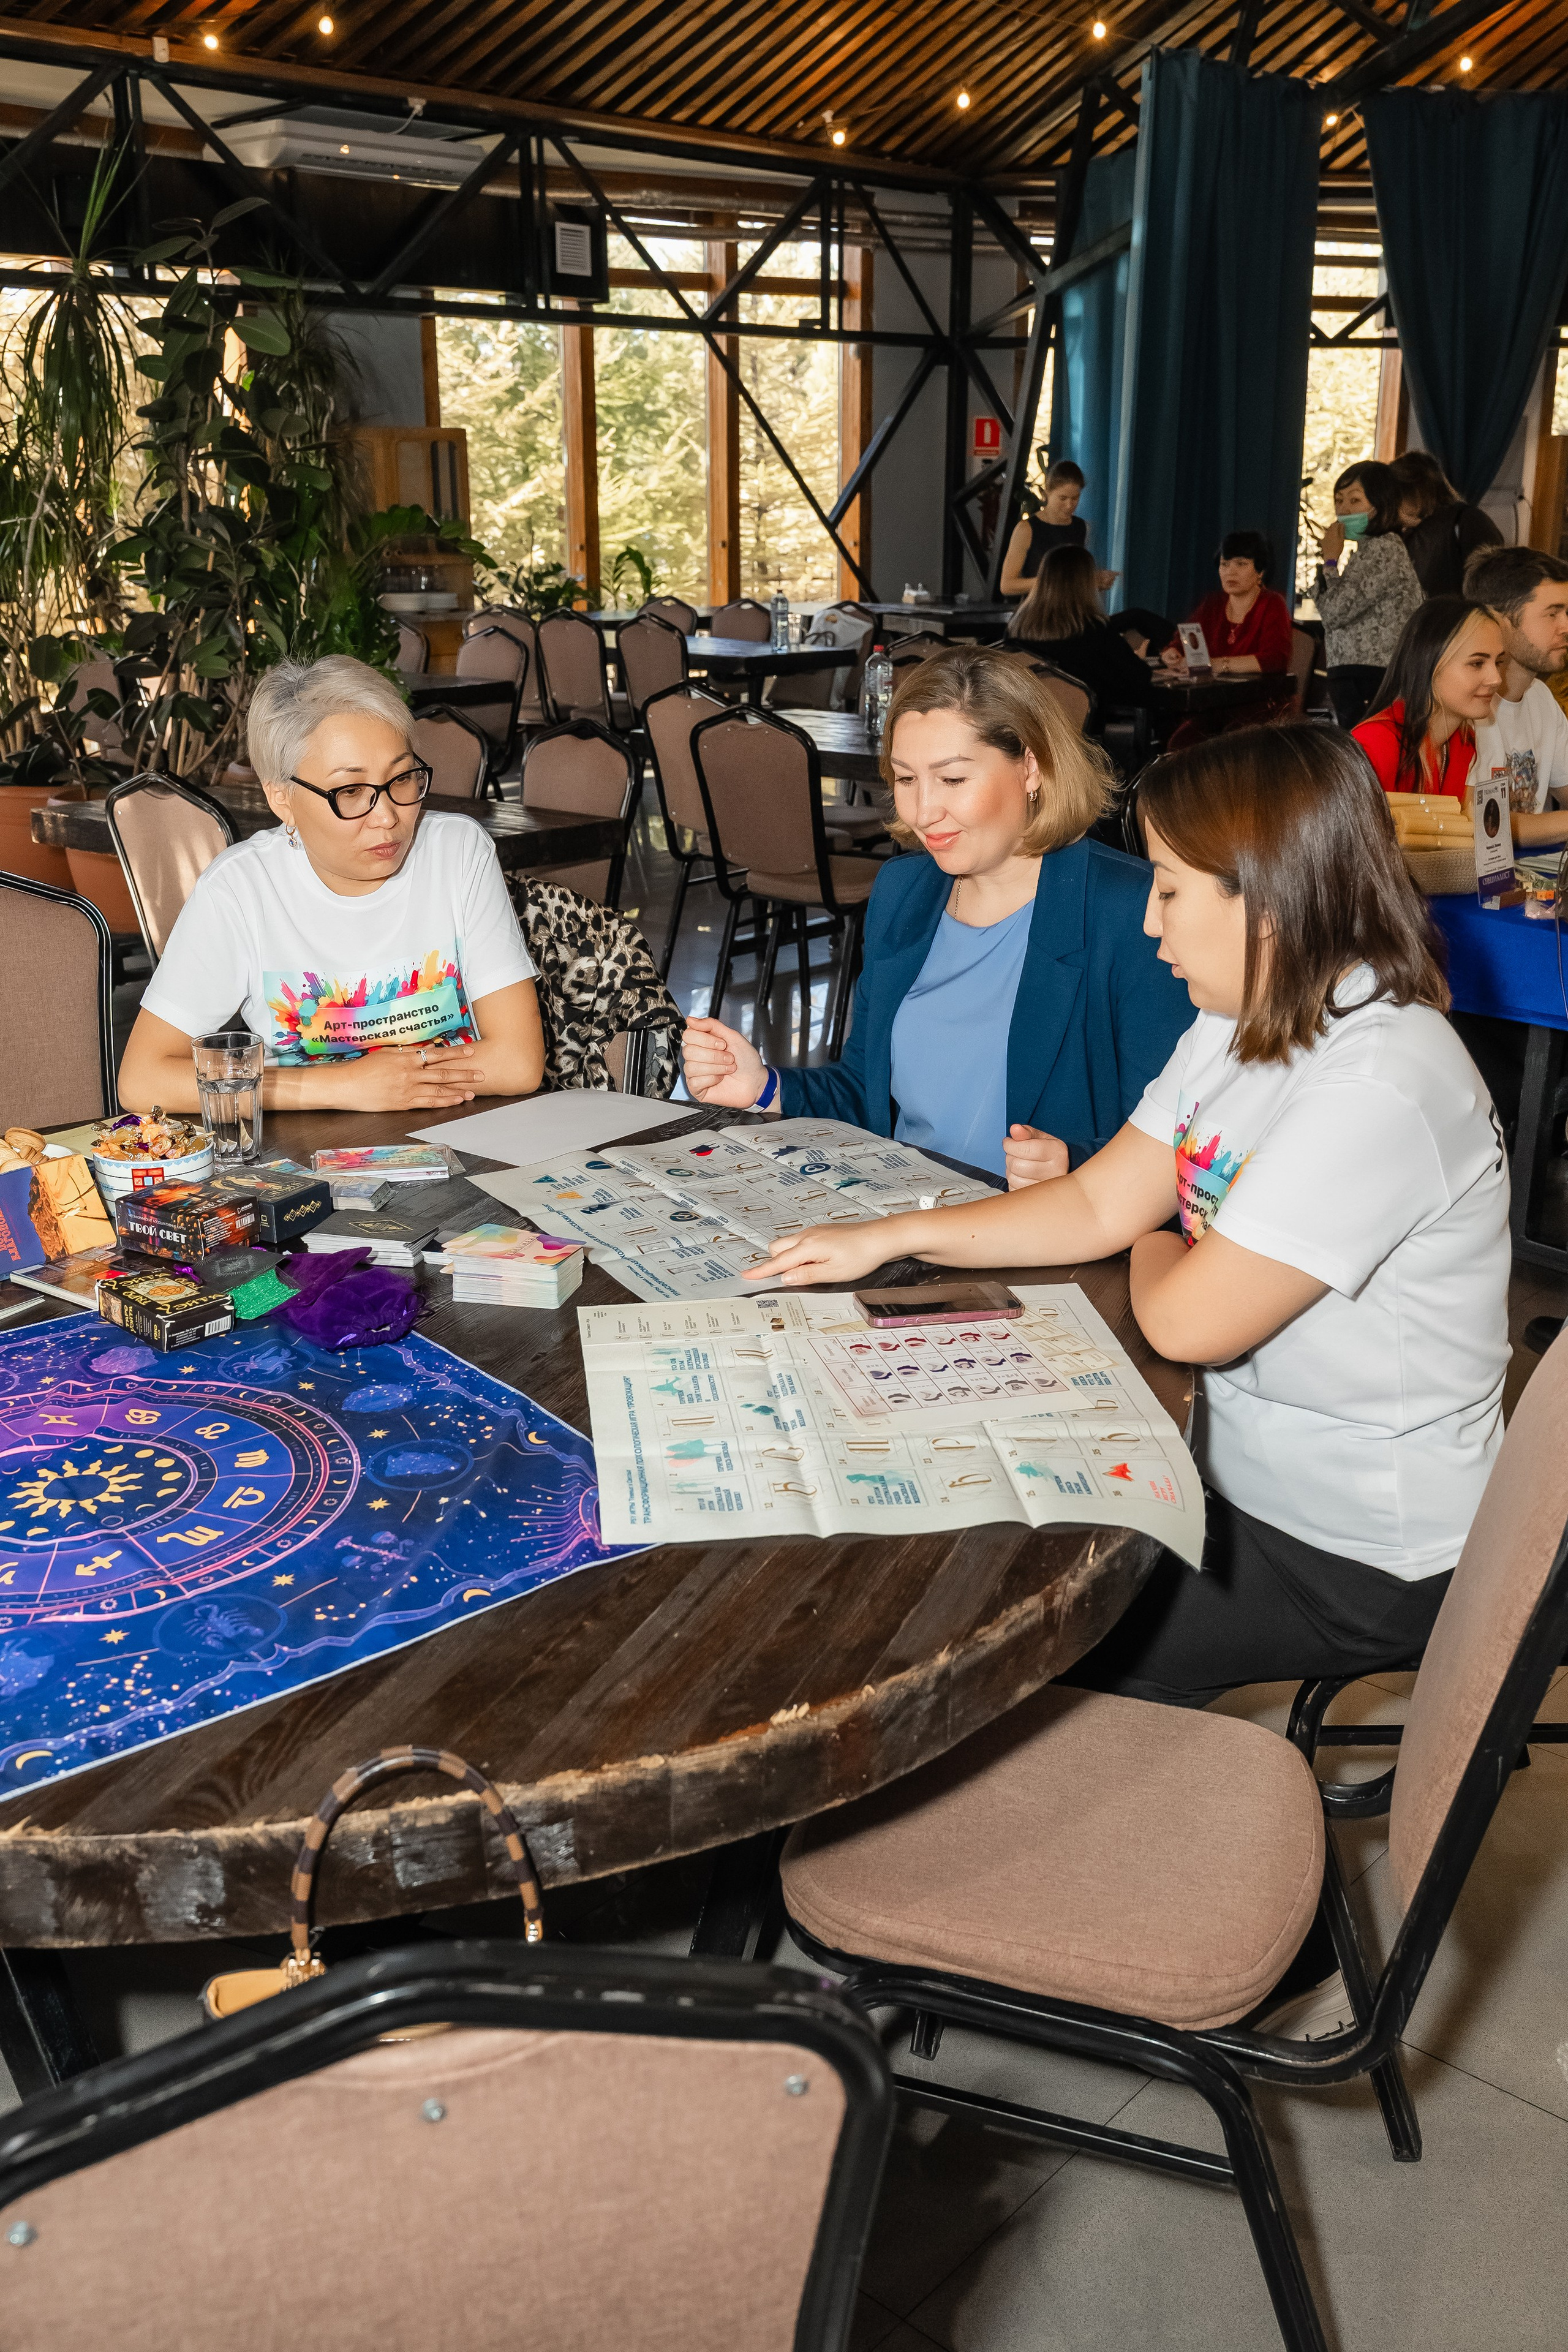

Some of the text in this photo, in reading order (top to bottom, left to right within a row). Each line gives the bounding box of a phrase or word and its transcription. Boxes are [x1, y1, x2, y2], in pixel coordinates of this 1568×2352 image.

[311, 1011, 455, 1044] «Мастерская счастья»
[323, 1003, 439, 1031] Арт-пространство
[128, 1221, 157, 1237] ТВОЙ
[159, 1230, 187, 1245] СВЕТ
[594, 1238, 631, 1260] ПХОЛОГИЧЕСКАЯ
[630, 1259, 679, 1295] ТРАНСФОРМАЦИОННАЯ
[624, 1376, 635, 1409] "ПРОВОКАЦИЯ"
[637, 1466, 652, 1524] ТРАНСФОРМАЦИОННАЯ
